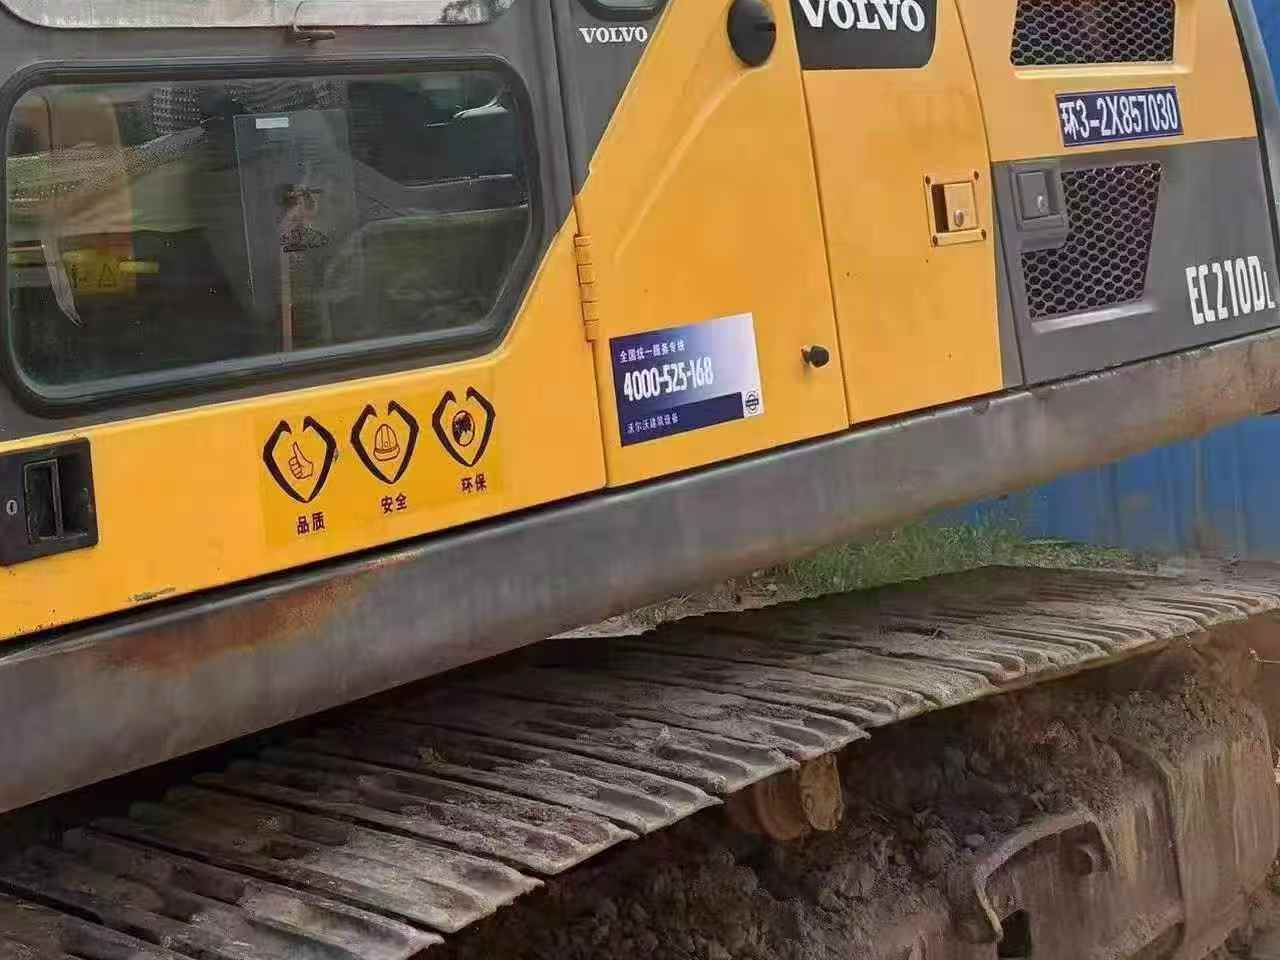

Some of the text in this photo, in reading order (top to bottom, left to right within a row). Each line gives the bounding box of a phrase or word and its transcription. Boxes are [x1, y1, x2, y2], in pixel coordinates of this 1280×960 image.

[580, 26, 648, 43] VOLVO
[1059, 93, 1178, 140] 环3-2X857030
[620, 339, 685, 363] 全国统一服务专线
[623, 356, 713, 402] 4000-525-168
[460, 473, 487, 492] 环保
[381, 494, 407, 514] 安全
[297, 511, 325, 534] 品质
